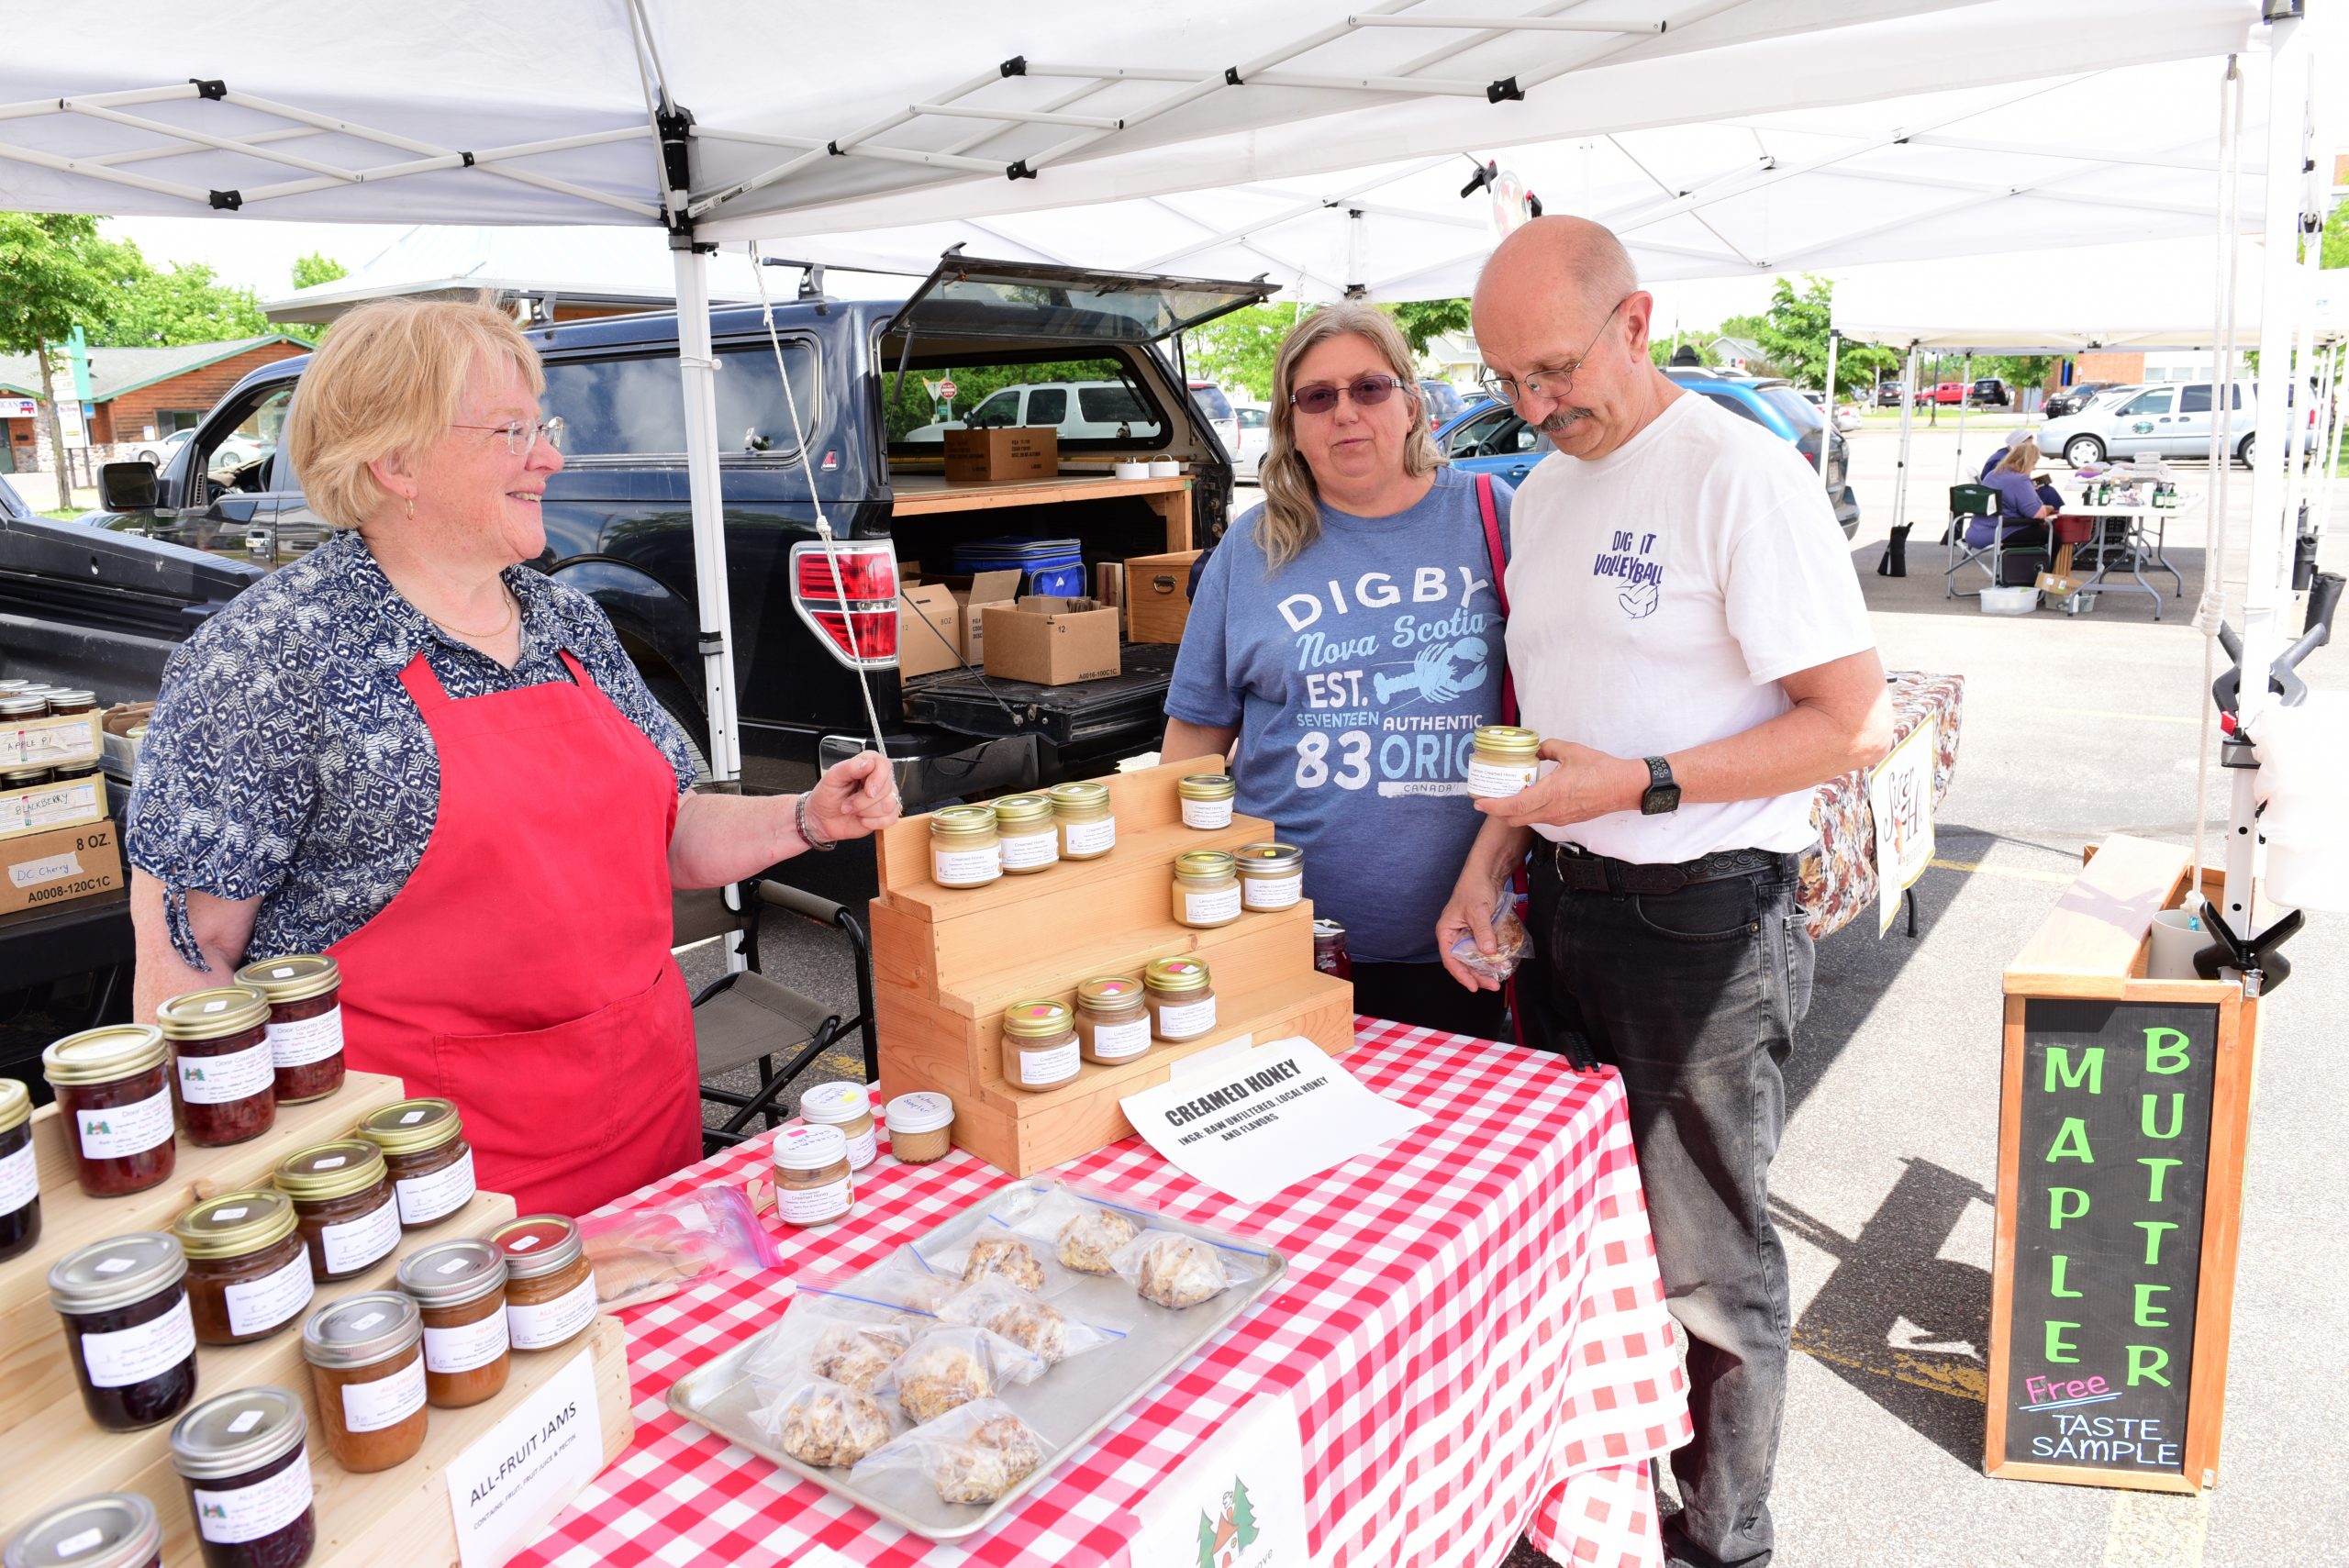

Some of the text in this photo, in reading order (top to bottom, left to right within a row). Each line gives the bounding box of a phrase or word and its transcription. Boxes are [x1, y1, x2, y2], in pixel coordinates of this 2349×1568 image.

[1612, 530, 1656, 555] DIG IT
[1594, 553, 1664, 586] VOLLEYBALL
[1277, 566, 1488, 632] DIGBY
[1058, 625, 1066, 633] 12
[1296, 607, 1487, 671] Nova Scotia
[1307, 670, 1368, 708] EST.
[1297, 711, 1483, 732] SEVENTEEN AUTHENTIC
[8, 740, 36, 751] APPLE
[1296, 730, 1372, 790] 83
[16, 793, 68, 815] BLACKBERRY
[1404, 784, 1453, 793] CANADA
[76, 833, 111, 851] 8 OZ.
[17, 864, 69, 881] DC Cherry
[28, 875, 111, 903] A0008-120C1C
[1164, 1058, 1301, 1128] CREAMED HONEY
[1178, 1129, 1207, 1146] INGR:
[1203, 1121, 1227, 1136] RAW
[1275, 1088, 1305, 1105] LOCAL
[1300, 1075, 1330, 1094] HONEY
[1220, 1113, 1280, 1142] AND FLAVORS
[2044, 1047, 2105, 1363] MAPLE
[2125, 1028, 2190, 1387] BUTTER
[2026, 1374, 2110, 1406] Free
[2052, 1414, 2163, 1441] TASTE
[470, 1402, 577, 1507] ALL-FRUIT JAMS
[523, 1468, 539, 1485] FRUIT
[558, 1433, 576, 1453] PECTIN
[2032, 1436, 2180, 1466] SAMPLE
